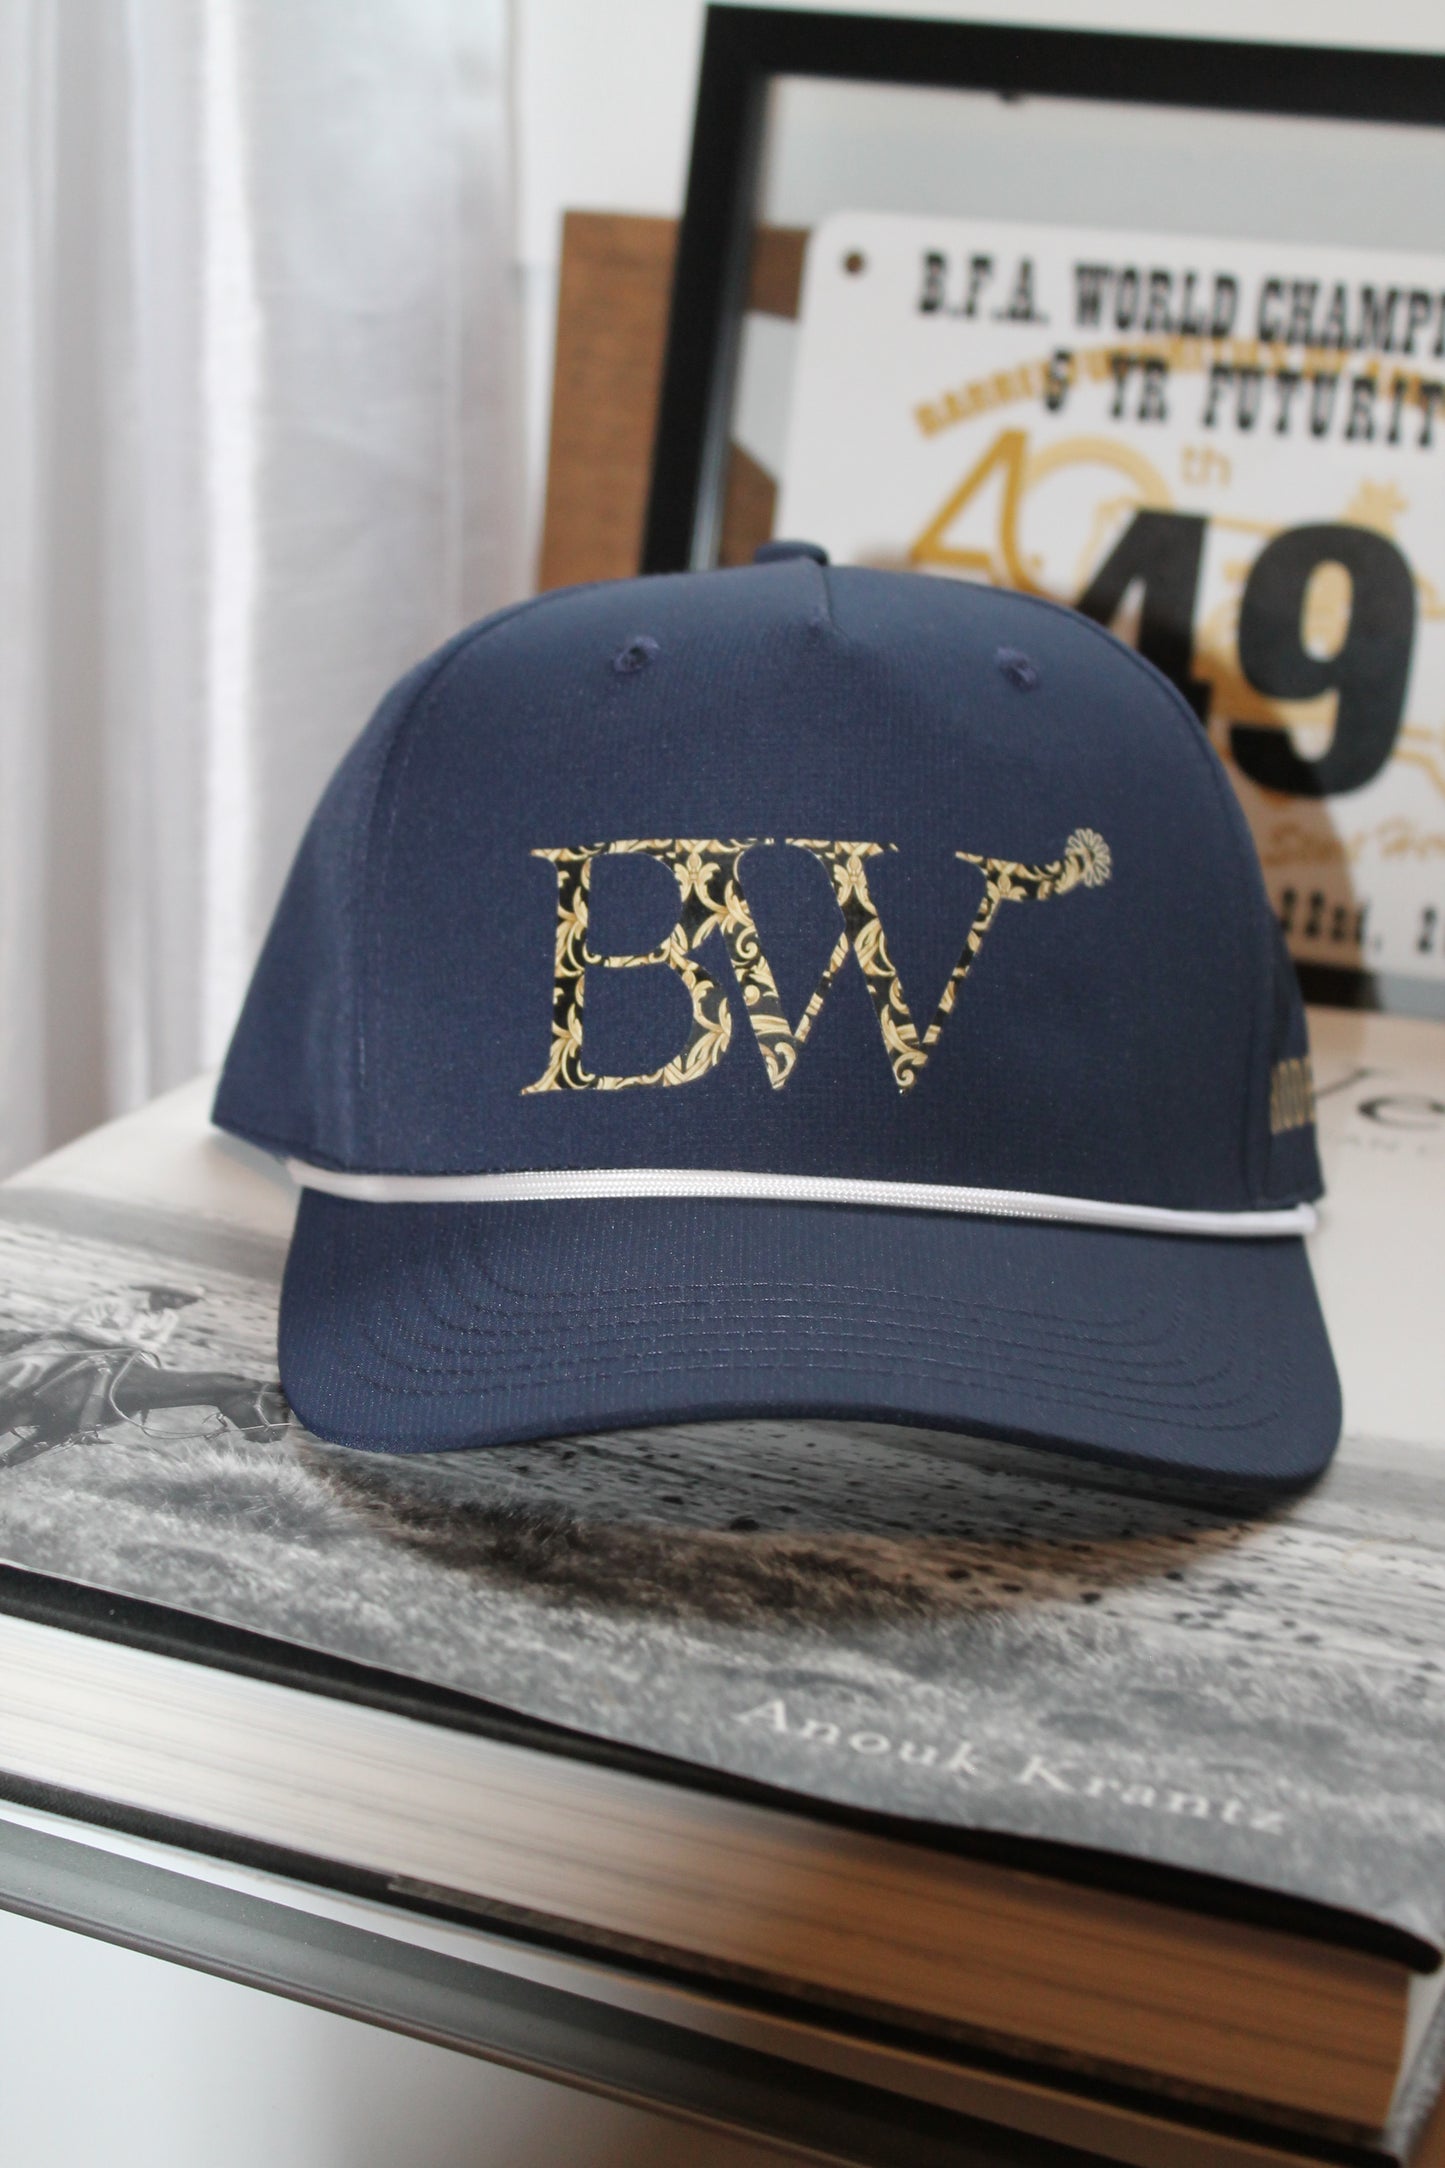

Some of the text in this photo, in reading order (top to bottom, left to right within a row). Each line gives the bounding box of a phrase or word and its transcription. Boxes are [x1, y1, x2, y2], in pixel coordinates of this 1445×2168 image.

[1074, 260, 1239, 338] WORLD
[1109, 353, 1170, 421] YR
[1202, 361, 1445, 449] FUTURIT
[1074, 506, 1417, 799] 49
[521, 827, 1113, 1095] BW
[737, 1699, 1287, 1836] Anouk Krantz
